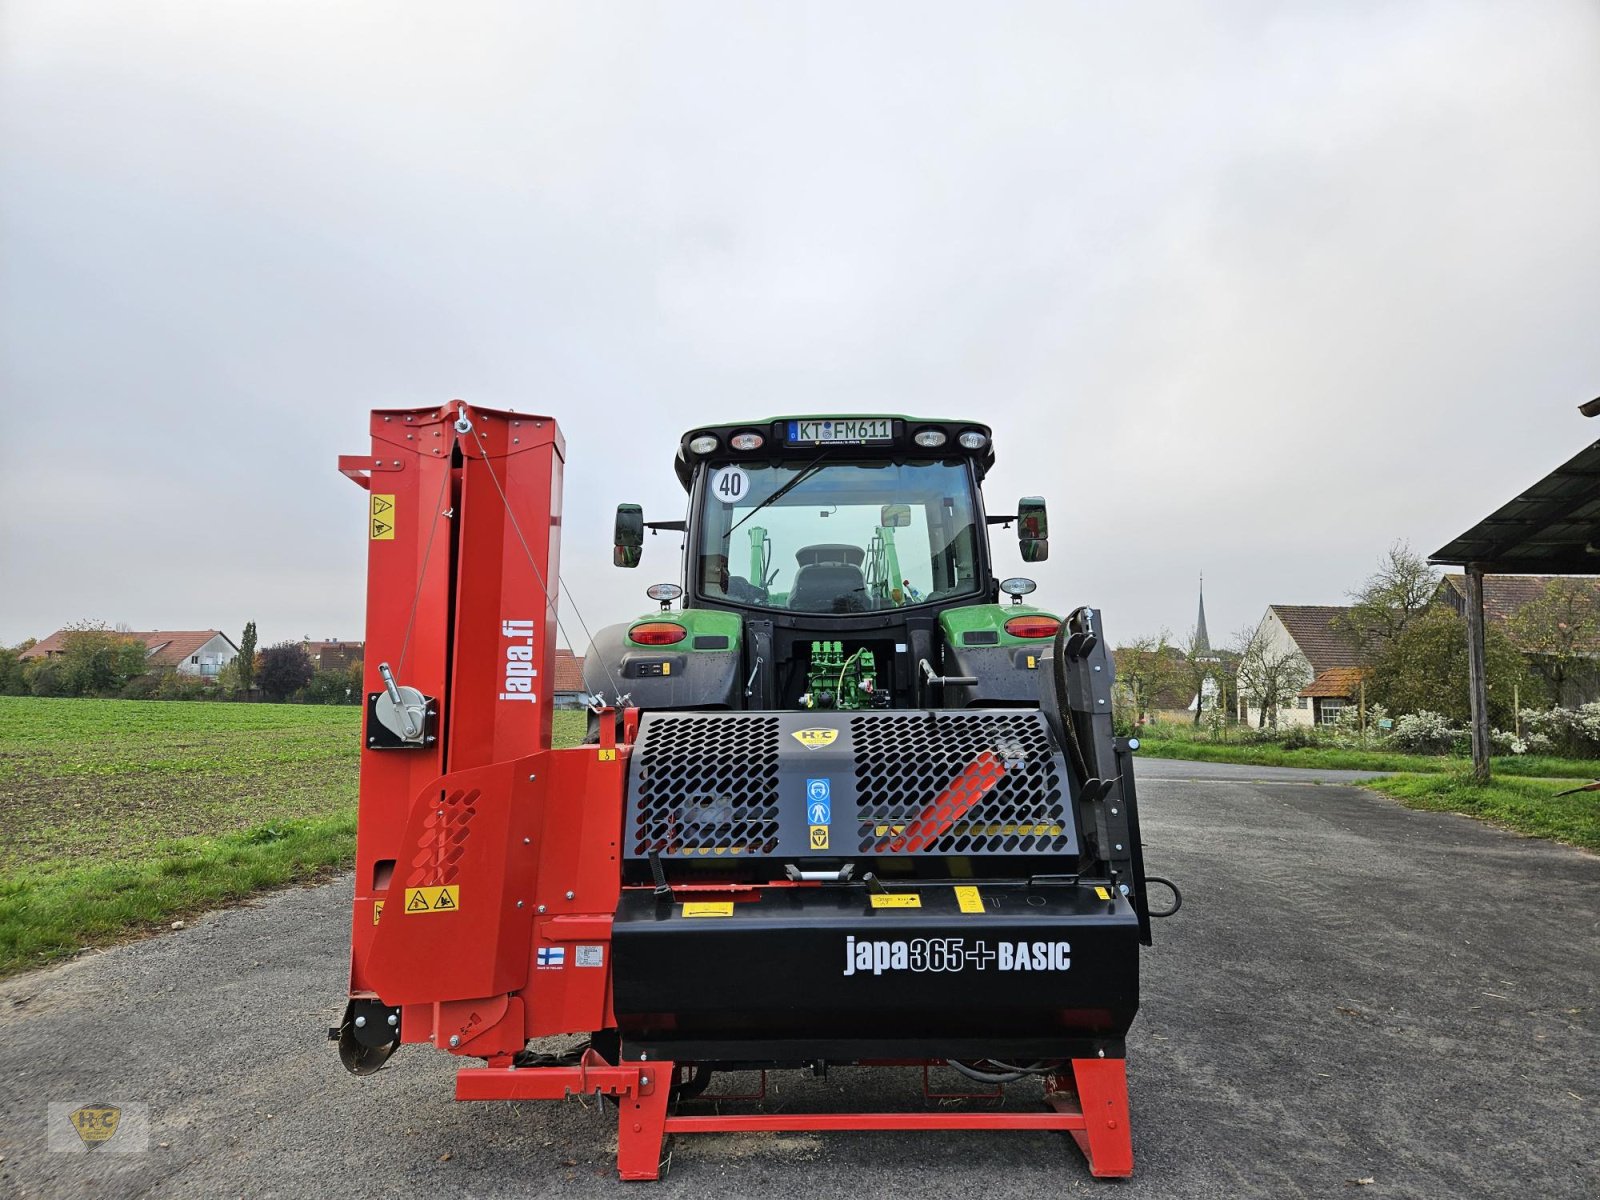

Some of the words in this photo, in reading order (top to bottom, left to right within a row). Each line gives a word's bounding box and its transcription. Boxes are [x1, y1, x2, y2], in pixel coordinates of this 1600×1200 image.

[800, 422, 821, 439] KT
[720, 473, 741, 496] 40
[499, 620, 537, 704] japa.fi
